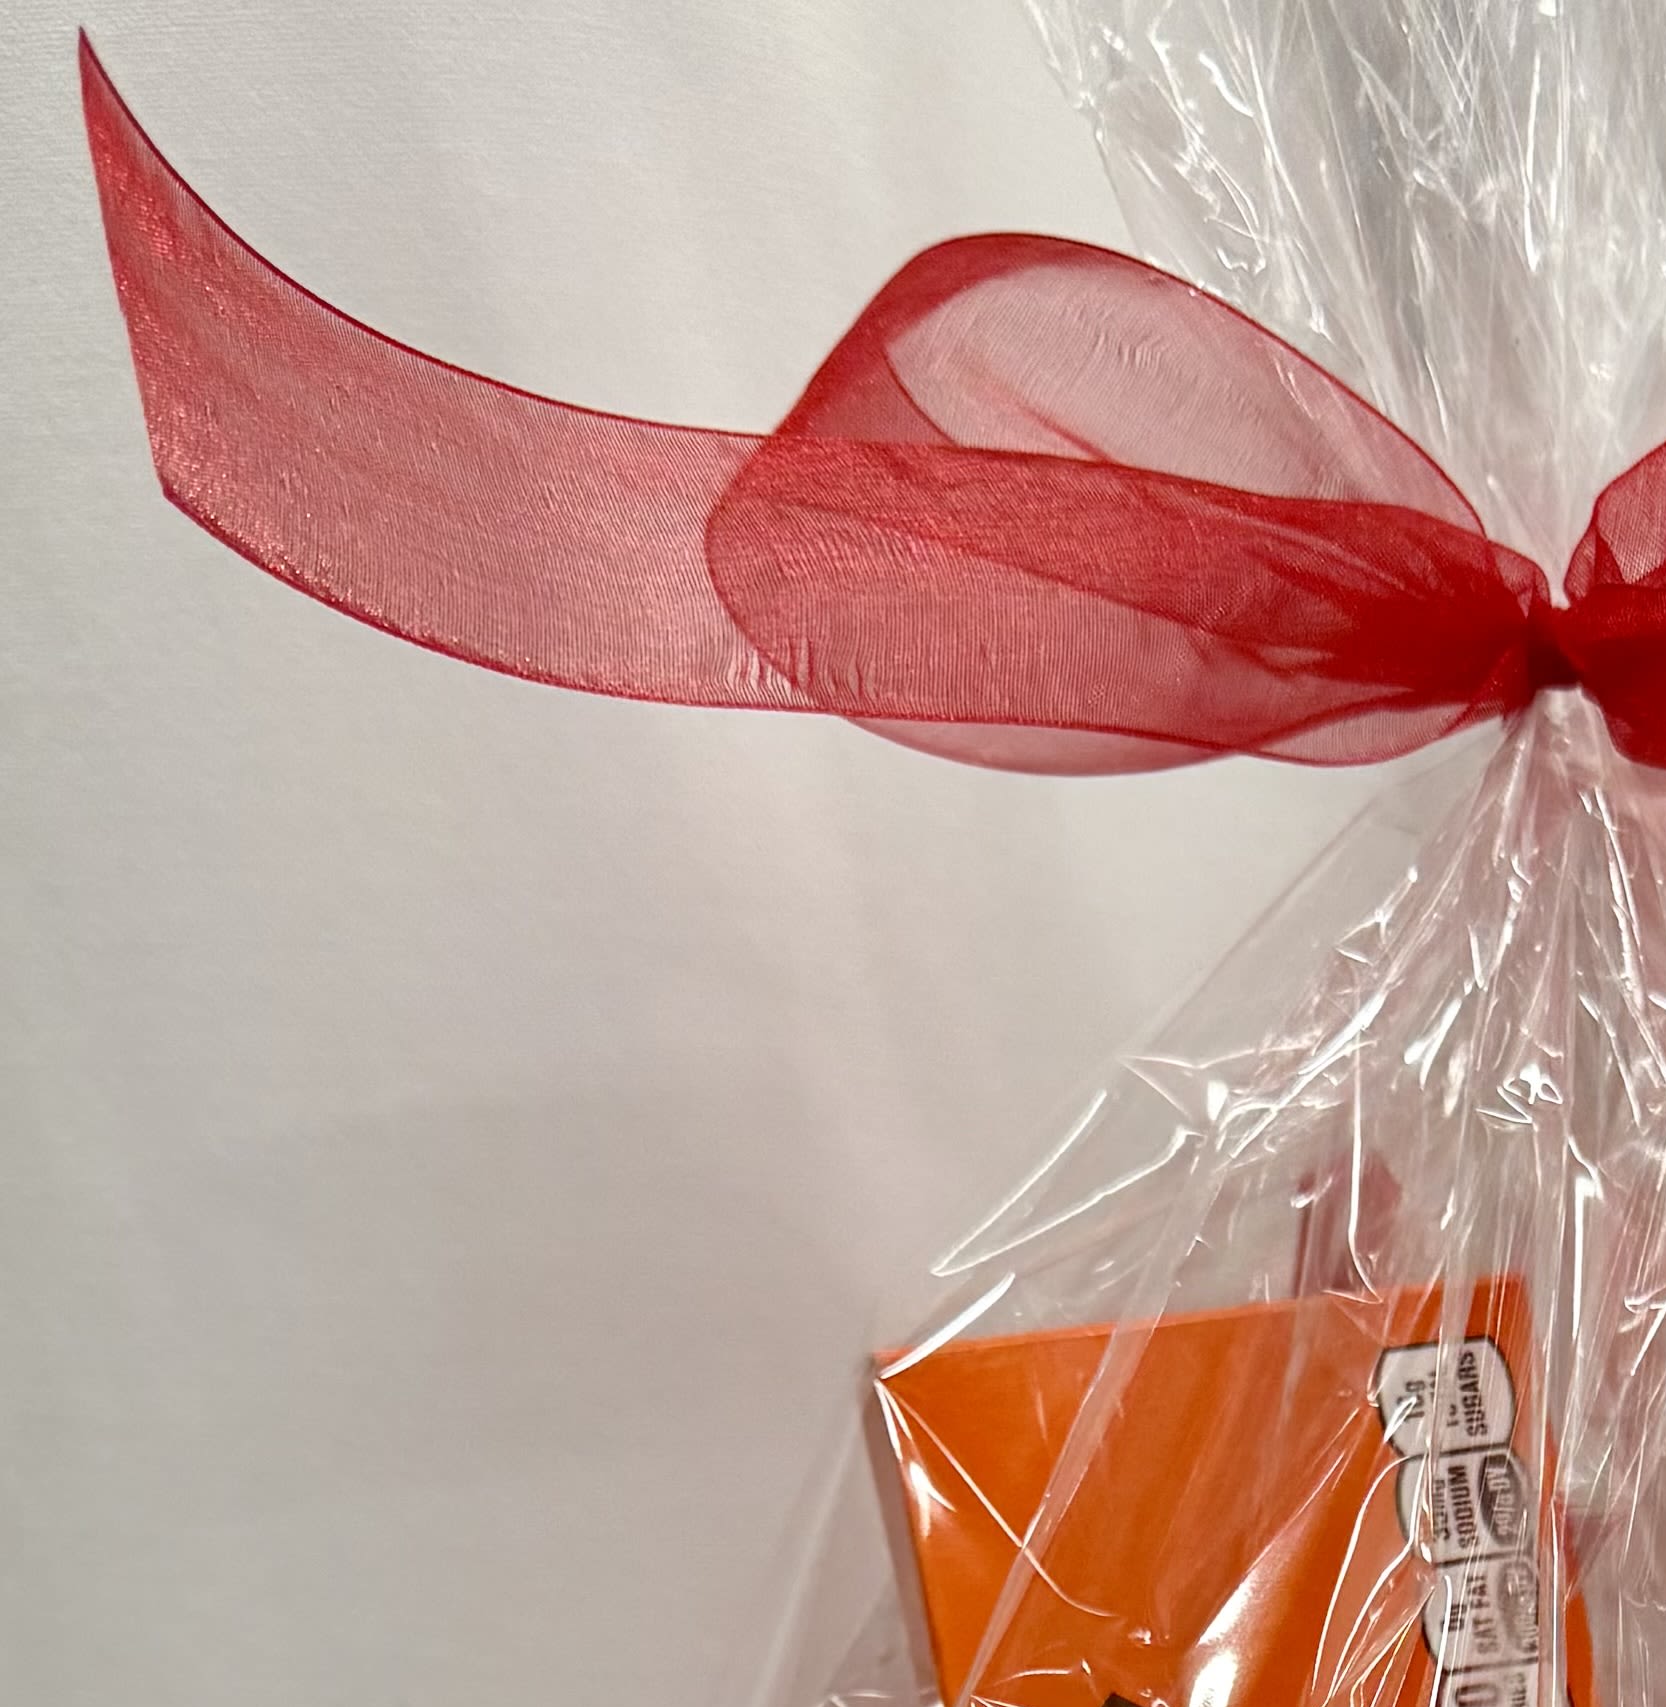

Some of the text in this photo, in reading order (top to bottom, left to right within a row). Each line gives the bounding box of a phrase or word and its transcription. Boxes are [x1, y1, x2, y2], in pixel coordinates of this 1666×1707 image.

[1458, 1350, 1488, 1437] SUGARS
[1447, 1465, 1479, 1549] SODIUM
[1466, 1573, 1499, 1655] SAT FAT
